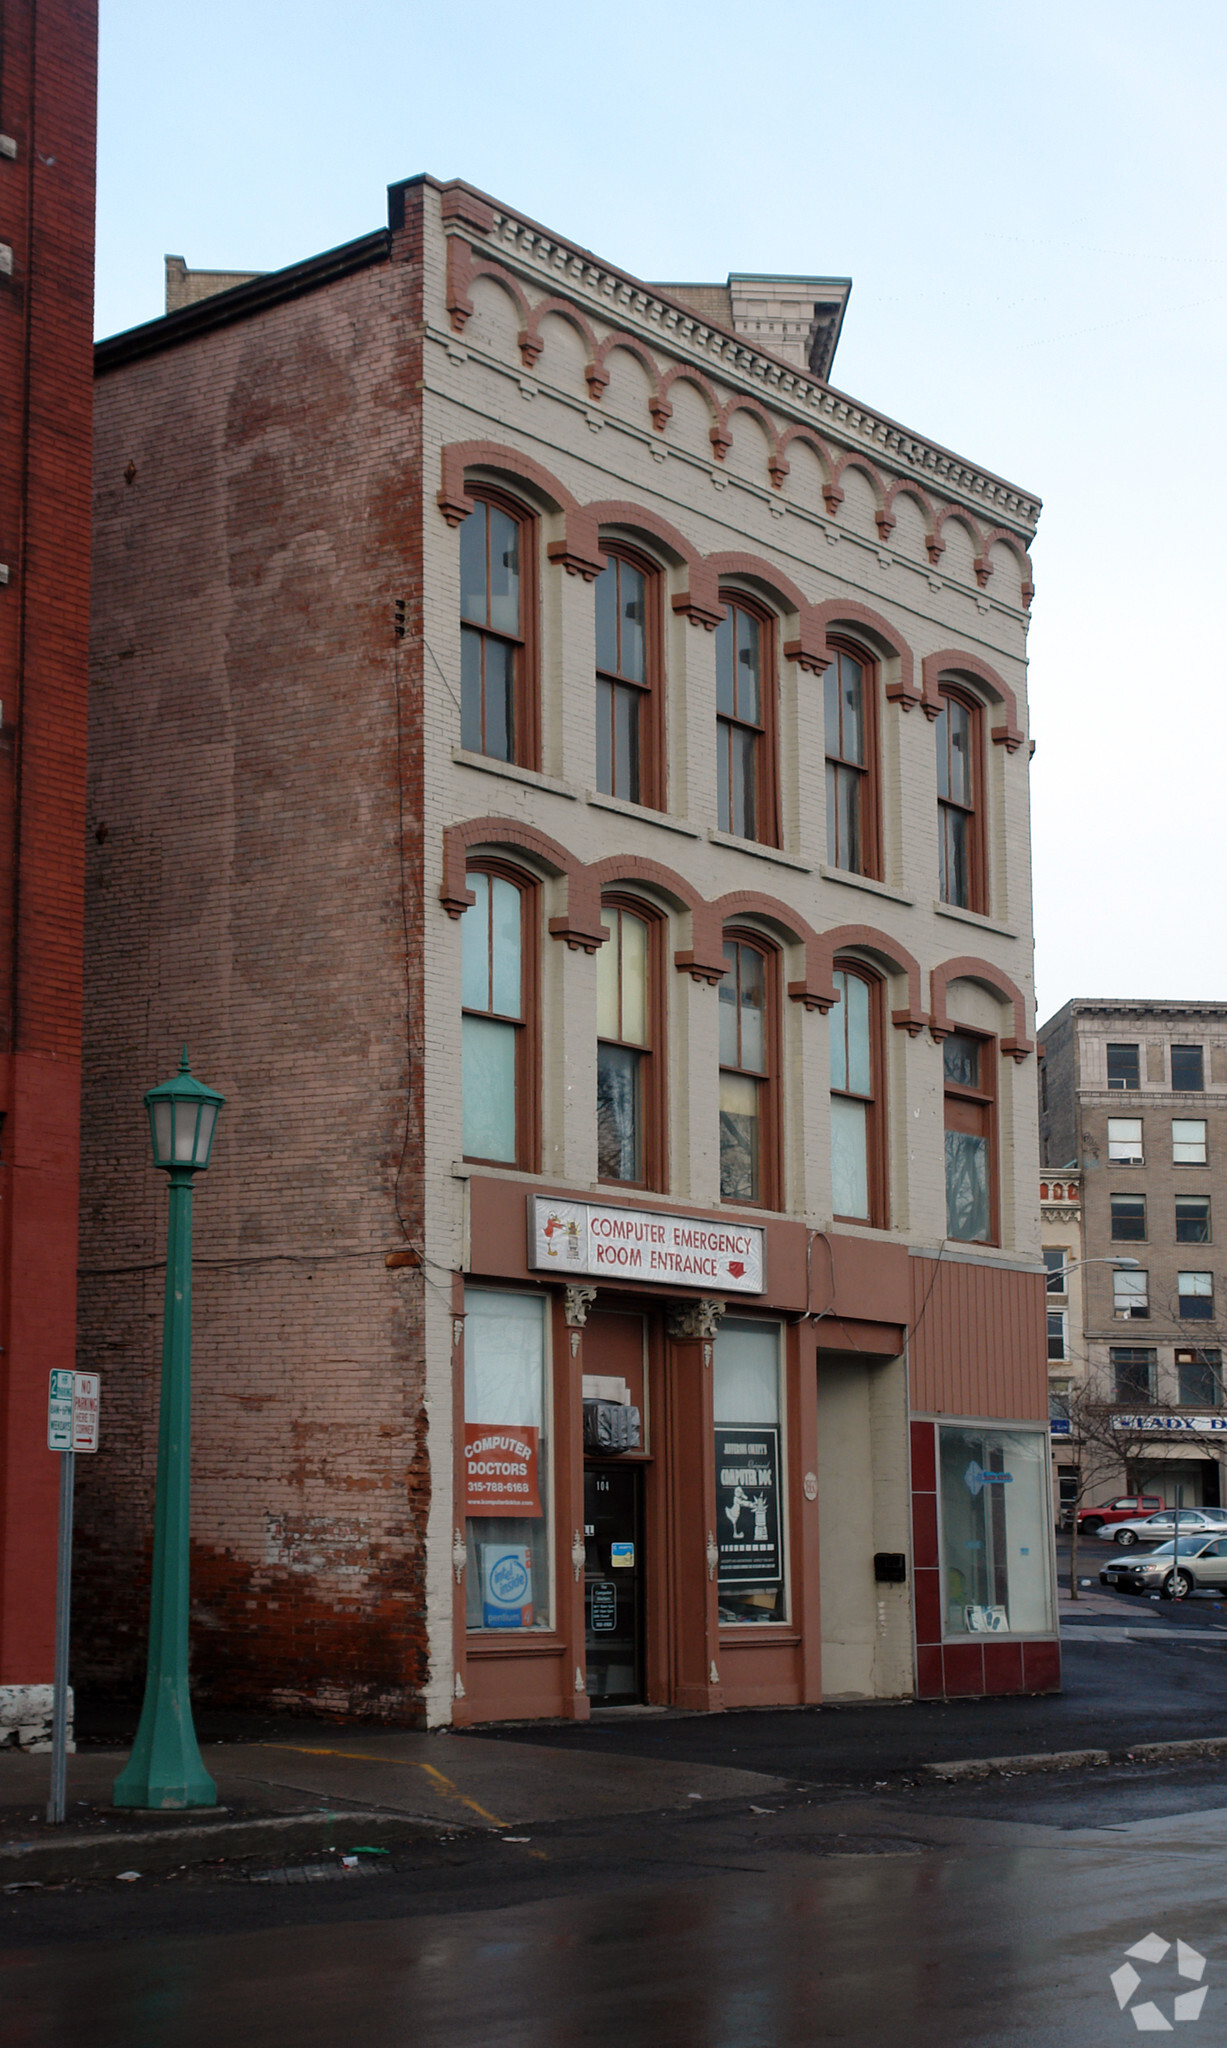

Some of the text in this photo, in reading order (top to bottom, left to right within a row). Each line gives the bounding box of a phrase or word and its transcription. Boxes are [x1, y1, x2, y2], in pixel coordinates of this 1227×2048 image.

[590, 1217, 752, 1255] COMPUTER EMERGENCY
[597, 1245, 717, 1277] ROOM ENTRANCE
[51, 1375, 57, 1395] 2
[81, 1380, 92, 1394] NO
[75, 1397, 98, 1411] PARKING
[76, 1412, 95, 1424] HERE TO
[1137, 1417, 1195, 1430] LADY
[76, 1424, 94, 1435] CORNER
[464, 1436, 533, 1461] COMPUTER
[468, 1461, 528, 1476] DOCTORS
[720, 1468, 772, 1486] COMPUTER DOC
[467, 1481, 530, 1493] 315-788-6168
[596, 1481, 610, 1491] 104
